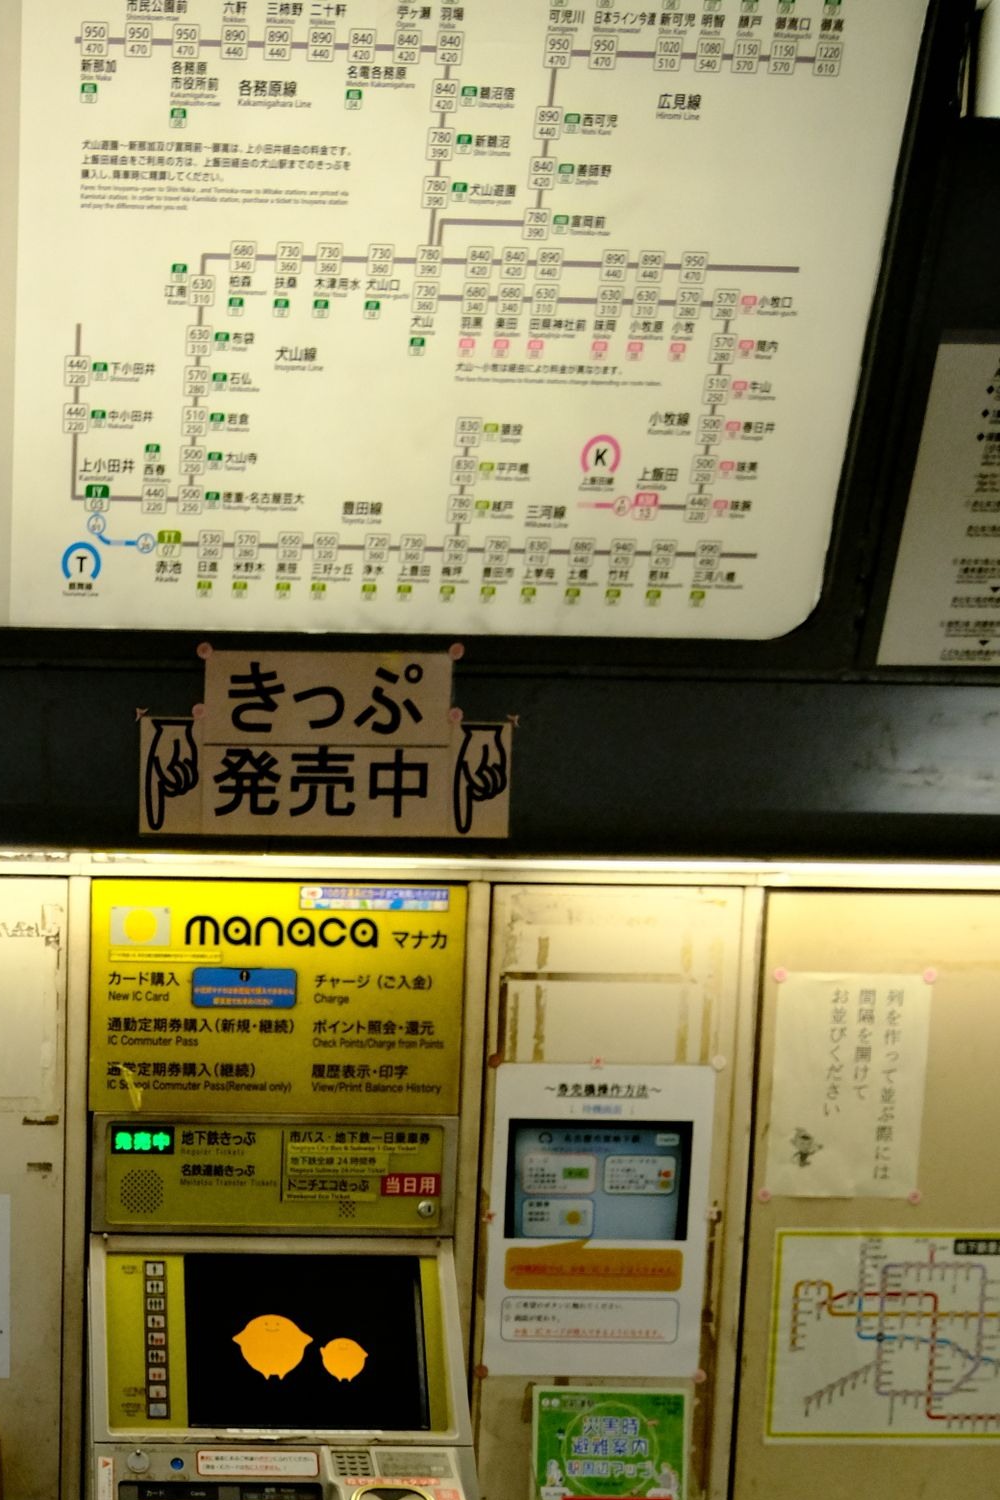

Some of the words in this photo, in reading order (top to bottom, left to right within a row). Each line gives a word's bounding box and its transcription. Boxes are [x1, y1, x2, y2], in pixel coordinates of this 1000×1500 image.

[85, 26, 106, 39] 950
[224, 29, 246, 42] 890
[818, 46, 841, 60] 1220
[239, 81, 297, 97] 各務原線
[658, 94, 702, 110] 広見線
[276, 348, 317, 362] 犬山線
[650, 412, 690, 426] 小牧線
[594, 449, 607, 466] K
[80, 459, 134, 473] 上小田井
[638, 468, 678, 482] 上飯田
[342, 502, 382, 515] 豊田線
[527, 505, 566, 519] 三河線
[228, 661, 423, 734] きっぷ
[214, 745, 428, 818] 発売中
[185, 915, 378, 947] manaca
[392, 931, 448, 949] マナカ
[108, 972, 179, 986] カード購入
[315, 974, 370, 989] チャージ
[378, 975, 432, 990] (ご入金)
[314, 993, 349, 1005] Charge
[313, 1020, 434, 1035] ポイント照会・還元
[312, 1064, 408, 1079] 履歴表示・印字
[366, 1083, 403, 1093] Balance
[407, 1084, 441, 1094] History
[115, 1131, 171, 1151] 発売中
[182, 1131, 256, 1145] 地下鉄きっぷ
[181, 1164, 255, 1176] 名鉄連絡きっぷ
[288, 1179, 370, 1192] ドニチエコきっぷ
[386, 1177, 435, 1193] 当日用
